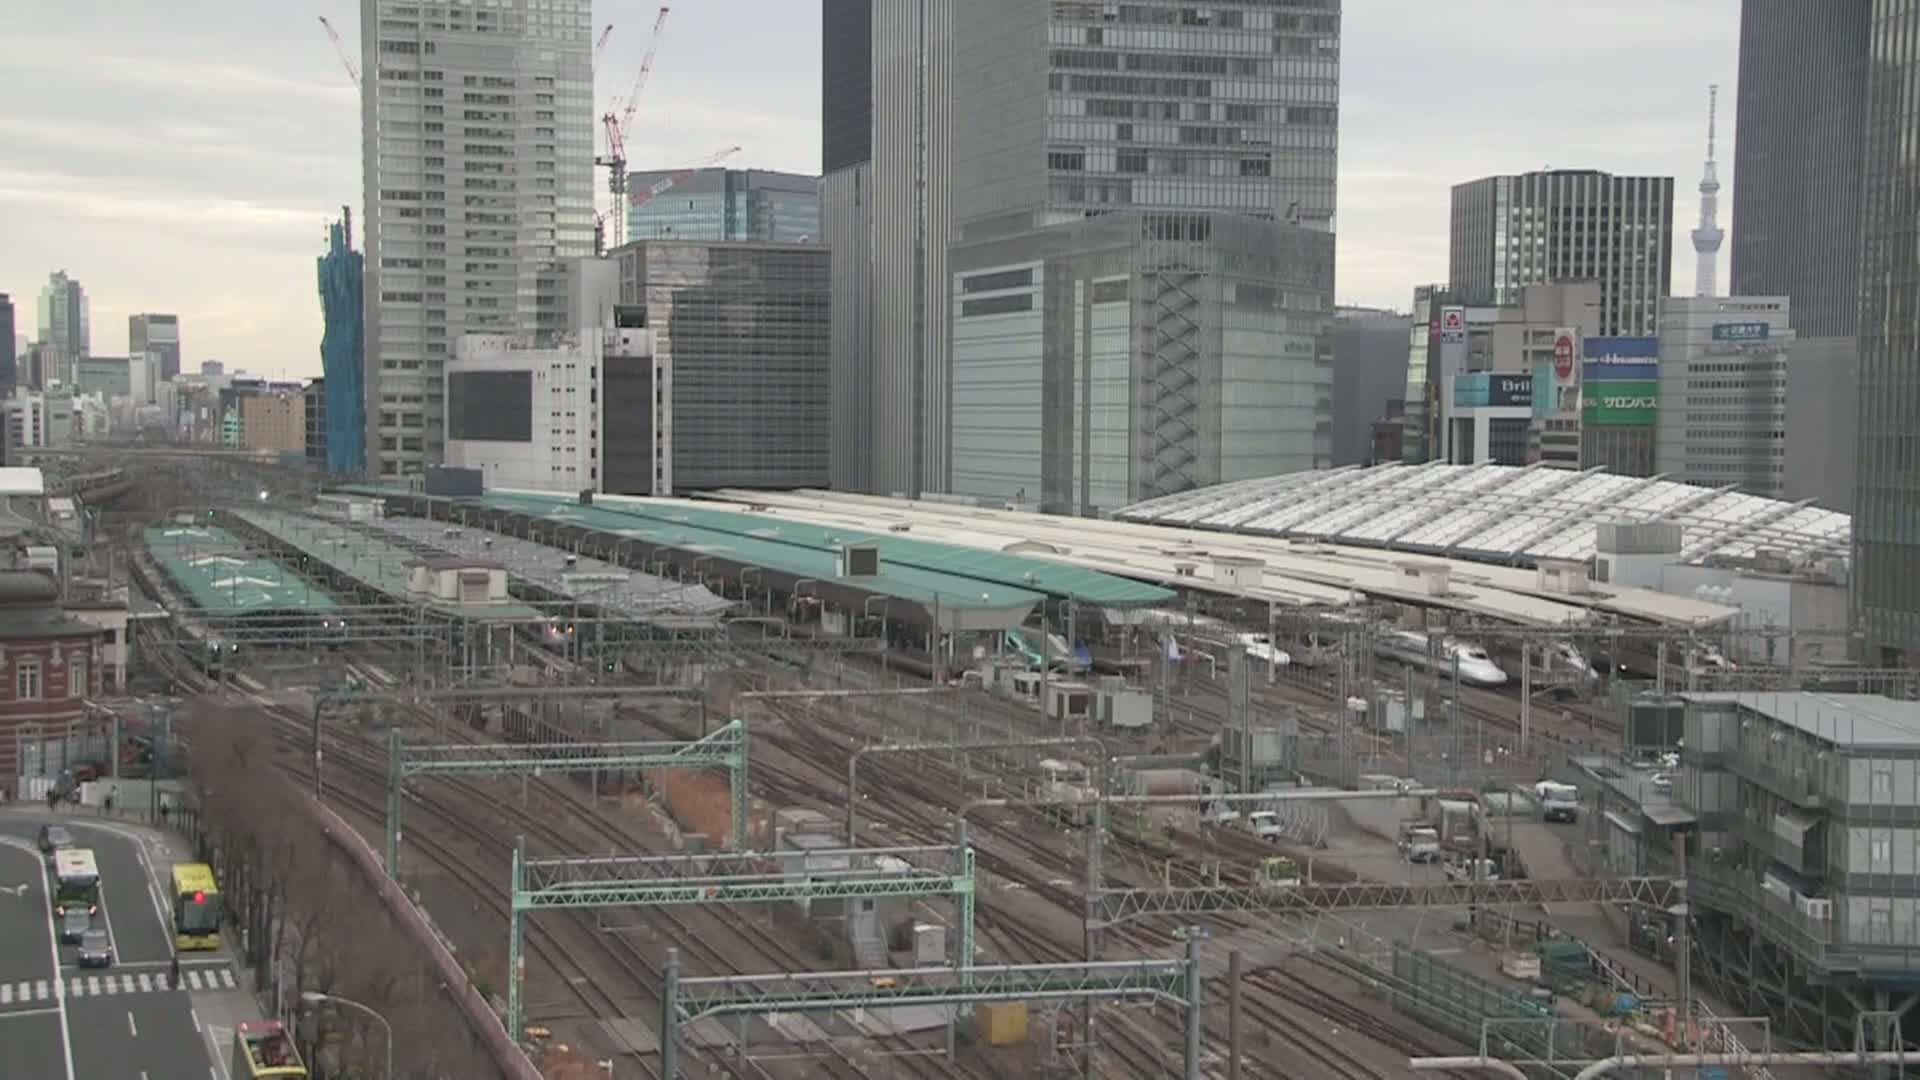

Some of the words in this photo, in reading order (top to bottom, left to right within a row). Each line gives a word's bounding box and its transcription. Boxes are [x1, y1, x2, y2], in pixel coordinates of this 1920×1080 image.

[1603, 396, 1657, 408] サロンパス
